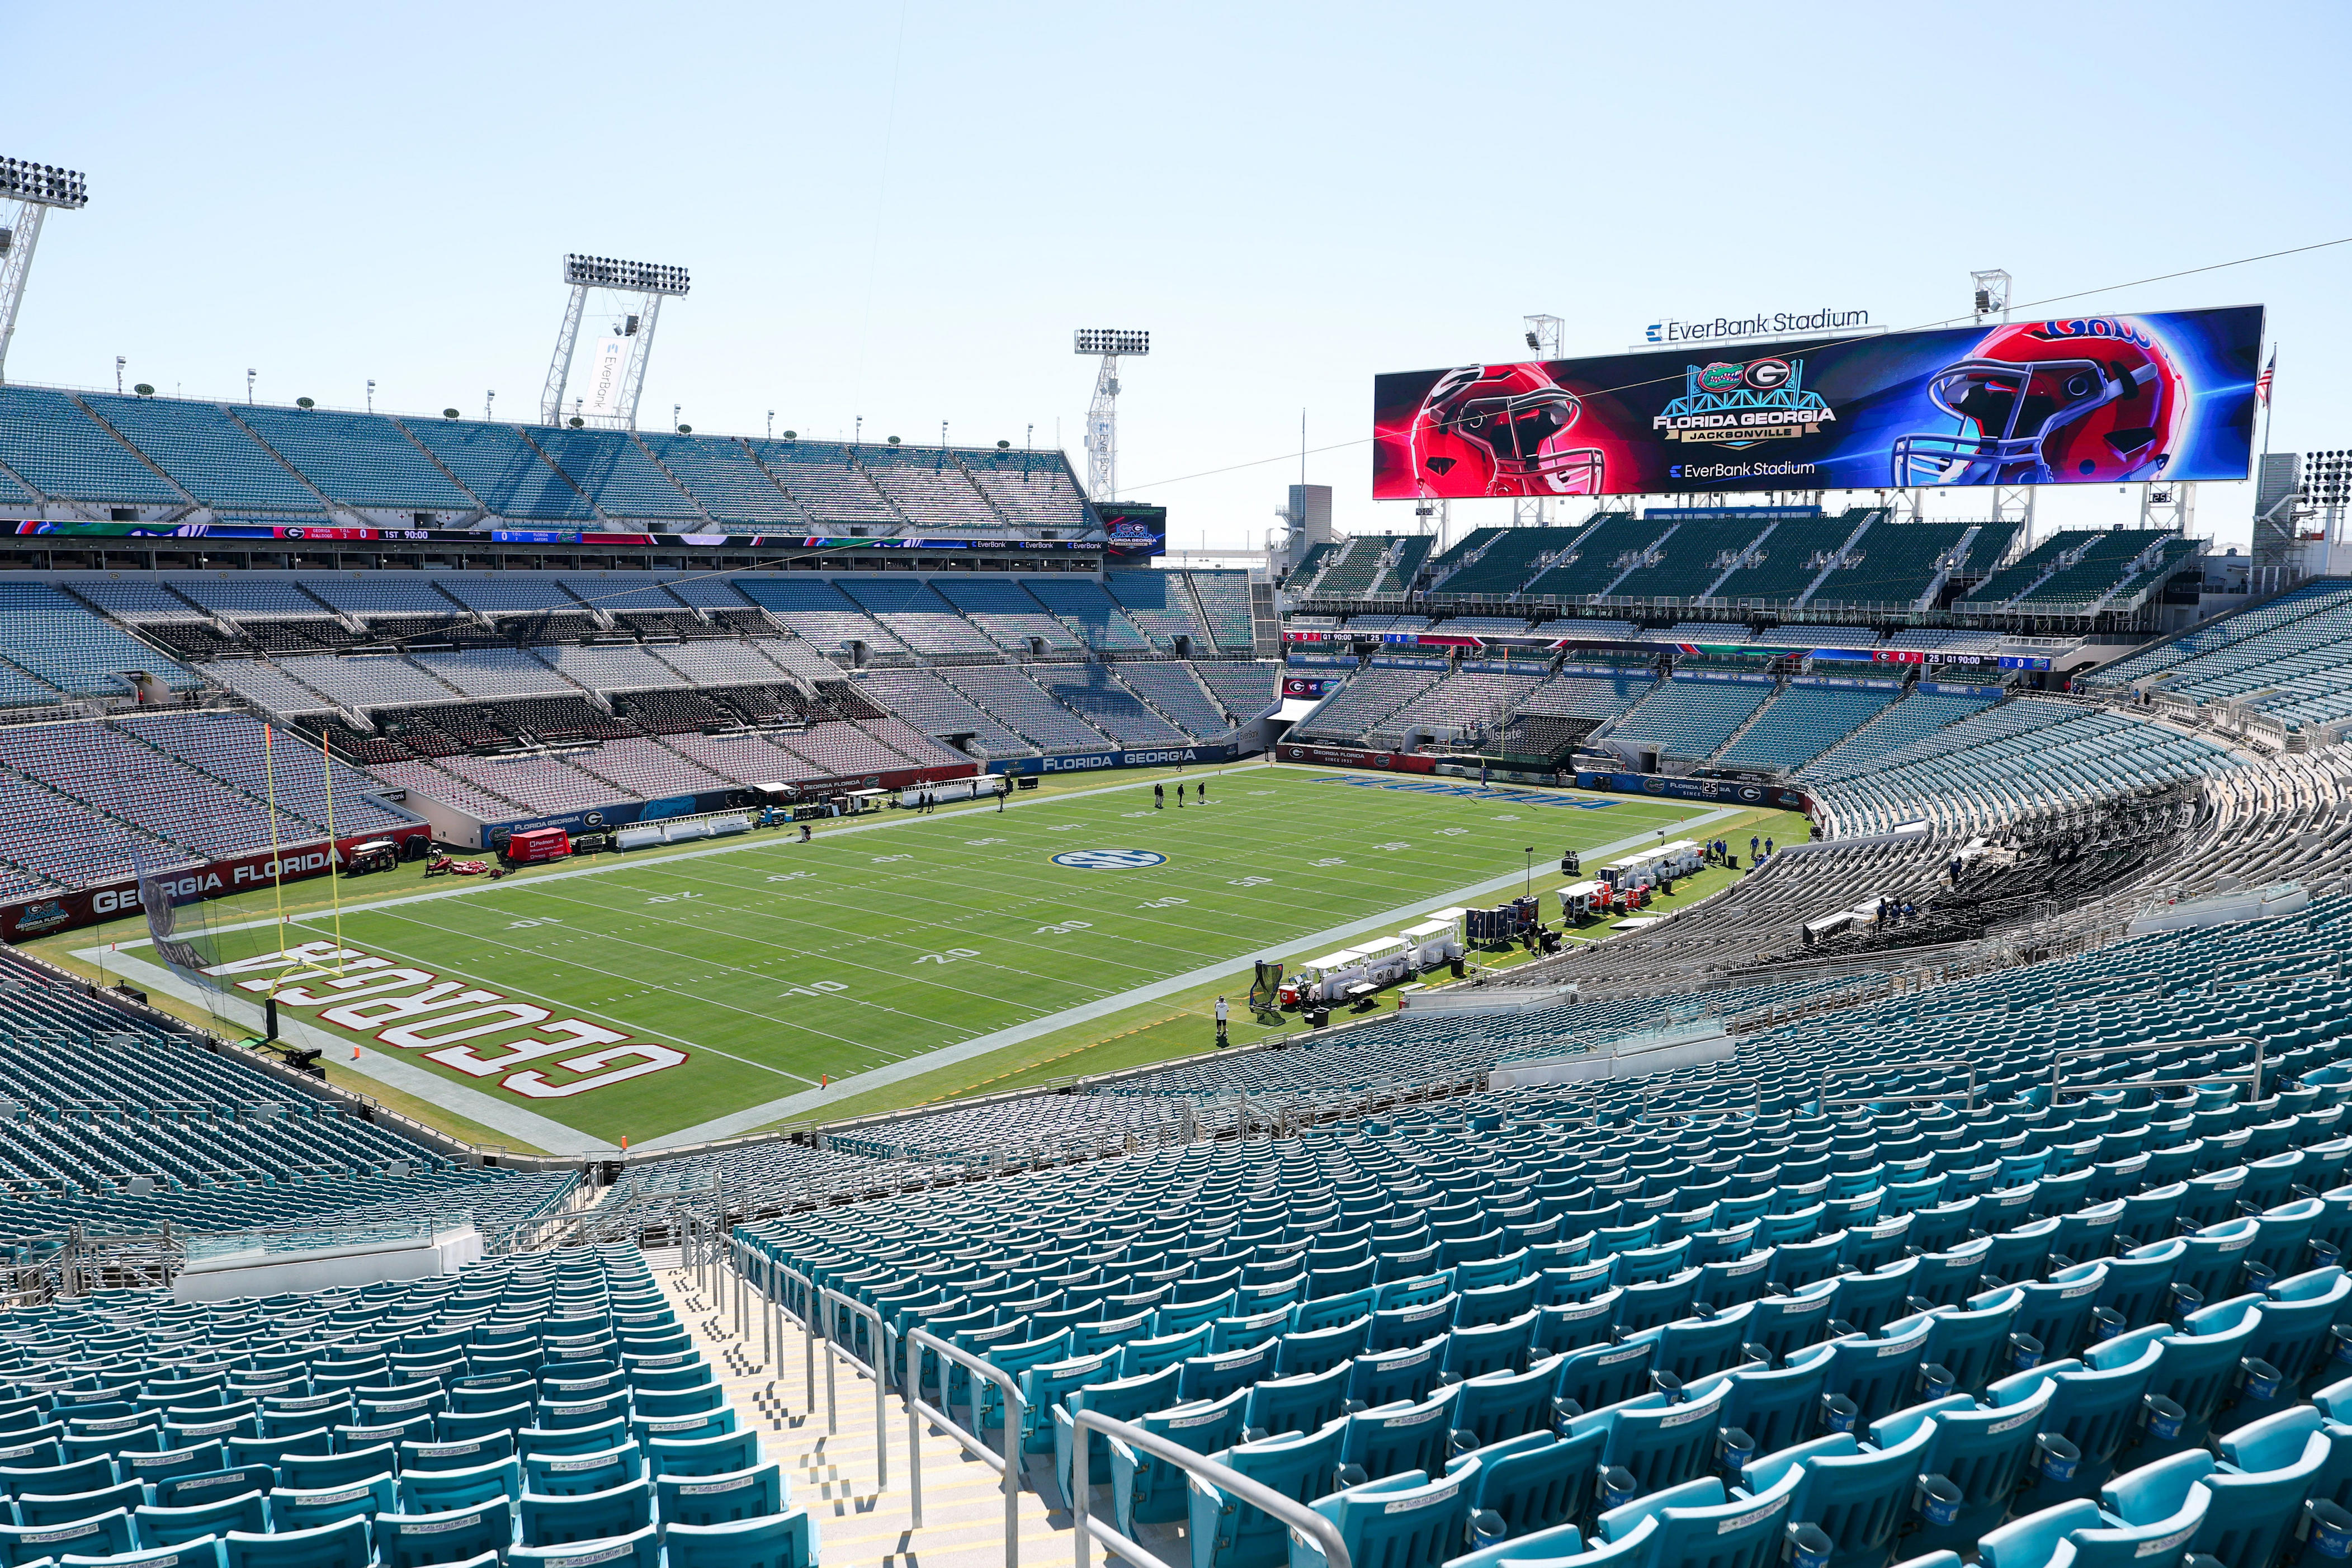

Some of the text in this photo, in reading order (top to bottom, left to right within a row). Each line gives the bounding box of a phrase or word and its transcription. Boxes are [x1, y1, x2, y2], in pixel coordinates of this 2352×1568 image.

[1669, 308, 1868, 341] EverBank Stadium
[593, 357, 617, 409] EverBank
[1653, 408, 1836, 430] FLORIDA GEORGIA
[1689, 428, 1792, 441] JACKSONVILLE
[1685, 461, 1815, 478] EverBank Stadium
[360, 529, 366, 538] 0
[404, 531, 428, 539] 90:00
[977, 540, 1006, 549] EverBank
[1898, 653, 1905, 661] 0
[1929, 654, 1939, 663] 25
[1947, 655, 1980, 664] Q1 90:00
[2018, 659, 2023, 668] 0
[1950, 685, 1967, 693] LIGHT
[1240, 729, 1258, 740] EverBank
[1482, 728, 1522, 741] Allstate
[1042, 748, 1196, 771] FLORIDA GEORGIA
[1704, 782, 1716, 792] 25
[514, 815, 580, 832] FLORIDA GEORGIA
[1433, 827, 1466, 836] 20
[1372, 841, 1407, 851] 30
[1056, 849, 1160, 869] SEC
[1307, 857, 1344, 867] 40
[233, 847, 344, 884] FLORIDA
[1227, 876, 1273, 887] 50
[647, 891, 704, 903] 20
[1145, 896, 1189, 908] 40
[15, 913, 70, 929] GEORGIA FLORIDA
[1038, 920, 1093, 934] 30
[918, 948, 981, 965] 20
[789, 980, 848, 996] 10
[196, 939, 690, 1099] GEORGIA
